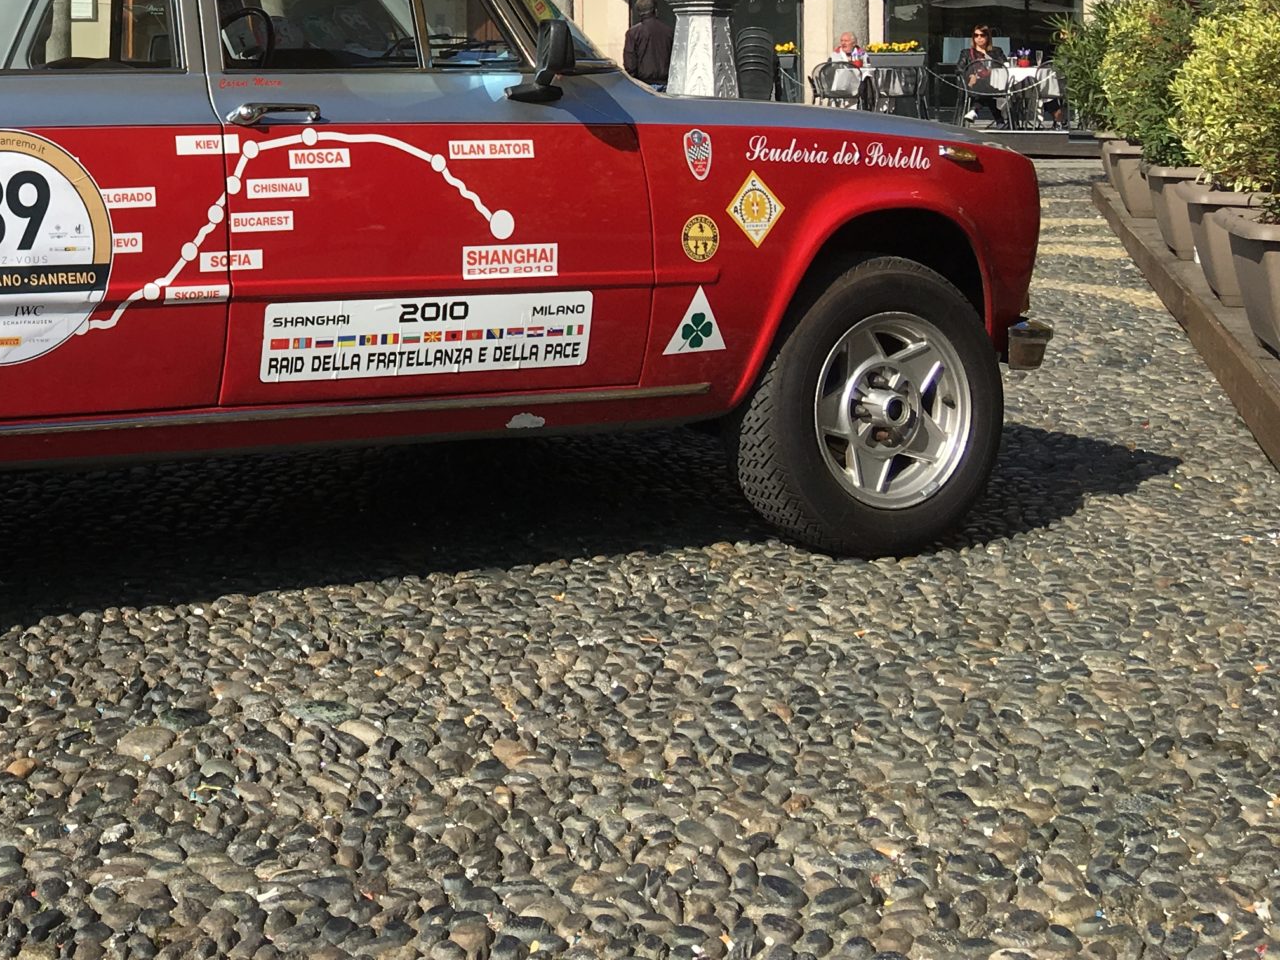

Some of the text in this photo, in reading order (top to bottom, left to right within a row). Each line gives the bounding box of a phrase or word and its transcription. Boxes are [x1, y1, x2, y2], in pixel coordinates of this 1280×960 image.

[195, 140, 220, 149] KIEV
[452, 143, 531, 155] ULAN BATOR
[294, 150, 344, 165] MOSCA
[745, 135, 829, 164] Scuderia
[864, 142, 932, 171] Portello
[253, 183, 303, 193] CHISINAU
[233, 216, 290, 227] BUCAREST
[210, 254, 251, 268] SOFIA
[466, 248, 554, 266] SHANGHAI
[467, 265, 553, 275] EXPO 2010
[29, 272, 96, 286] SANREMO
[174, 291, 220, 301] SKOPJIE
[14, 305, 45, 317] IWC
[272, 301, 585, 328] SHANGHAI 2010 MILANO
[267, 342, 581, 376] RAID DELLA FRATELLANZA E DELLA PACE
